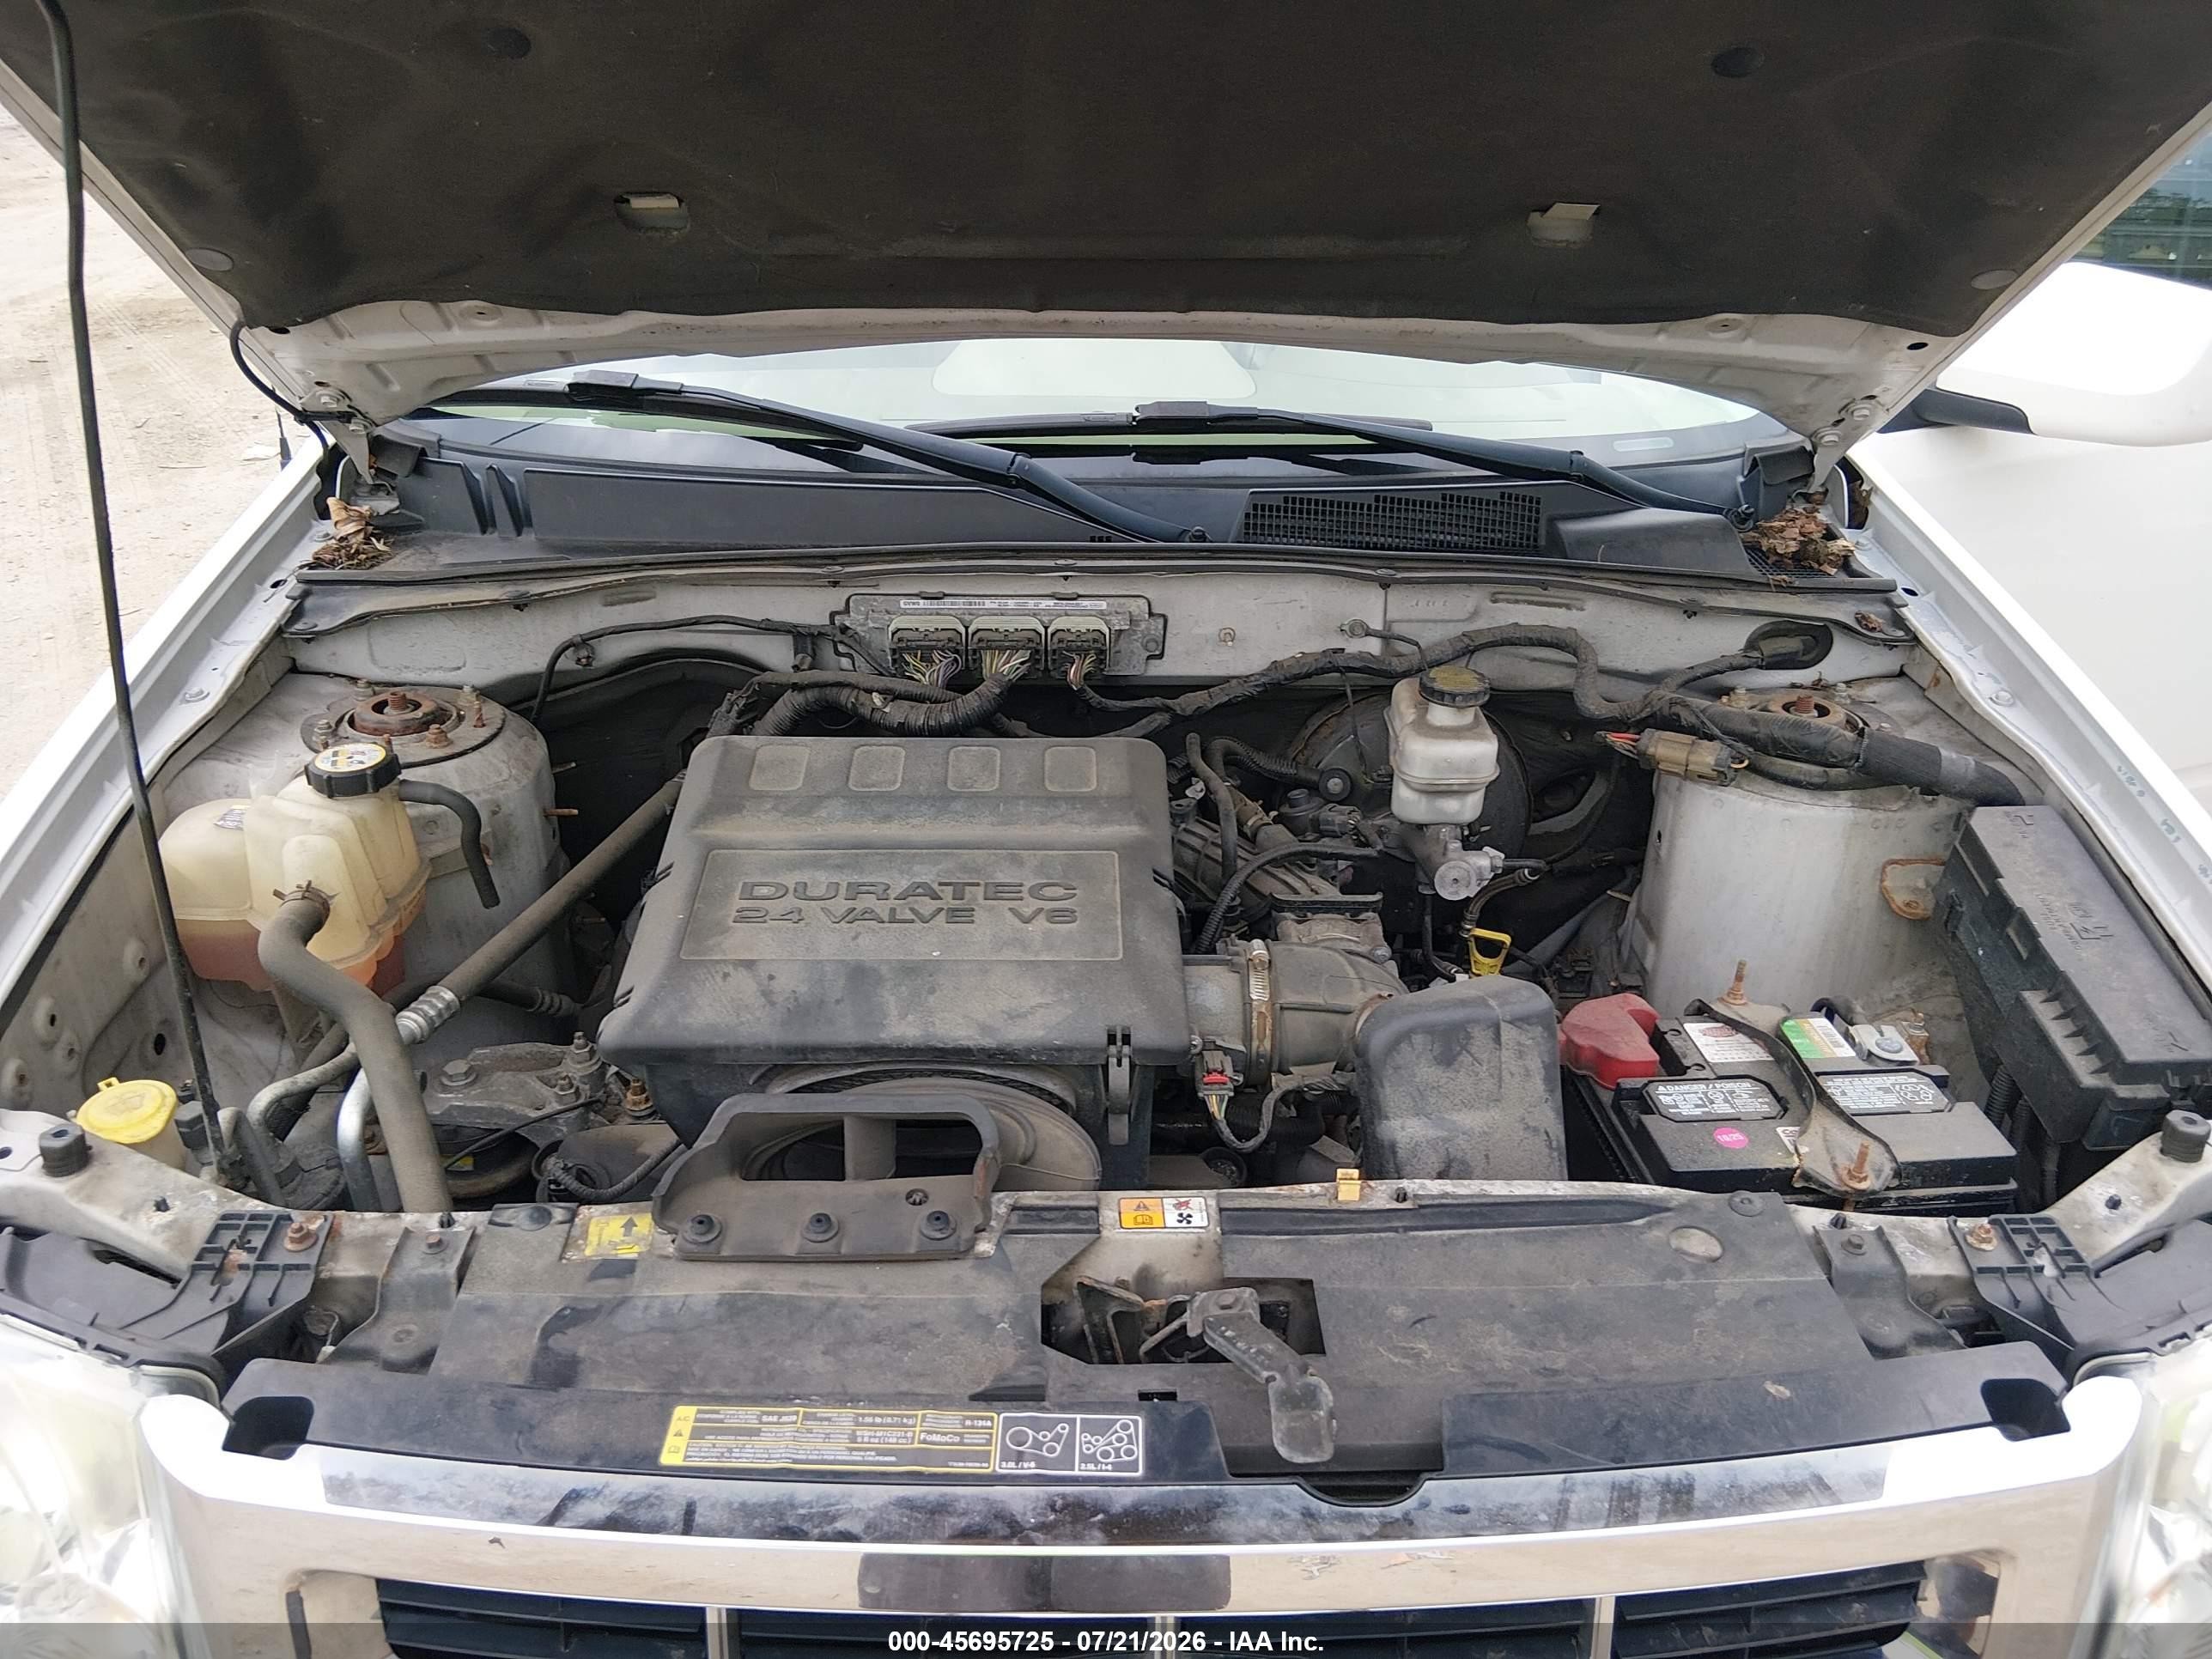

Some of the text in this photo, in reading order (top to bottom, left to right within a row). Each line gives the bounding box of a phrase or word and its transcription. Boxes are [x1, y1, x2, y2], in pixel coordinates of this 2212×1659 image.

[738, 881, 1079, 902] DURATEC
[732, 906, 1079, 924] 24 VALVE V6
[1667, 1084, 1706, 1092] DANGER
[919, 1432, 960, 1443] FoMoCo
